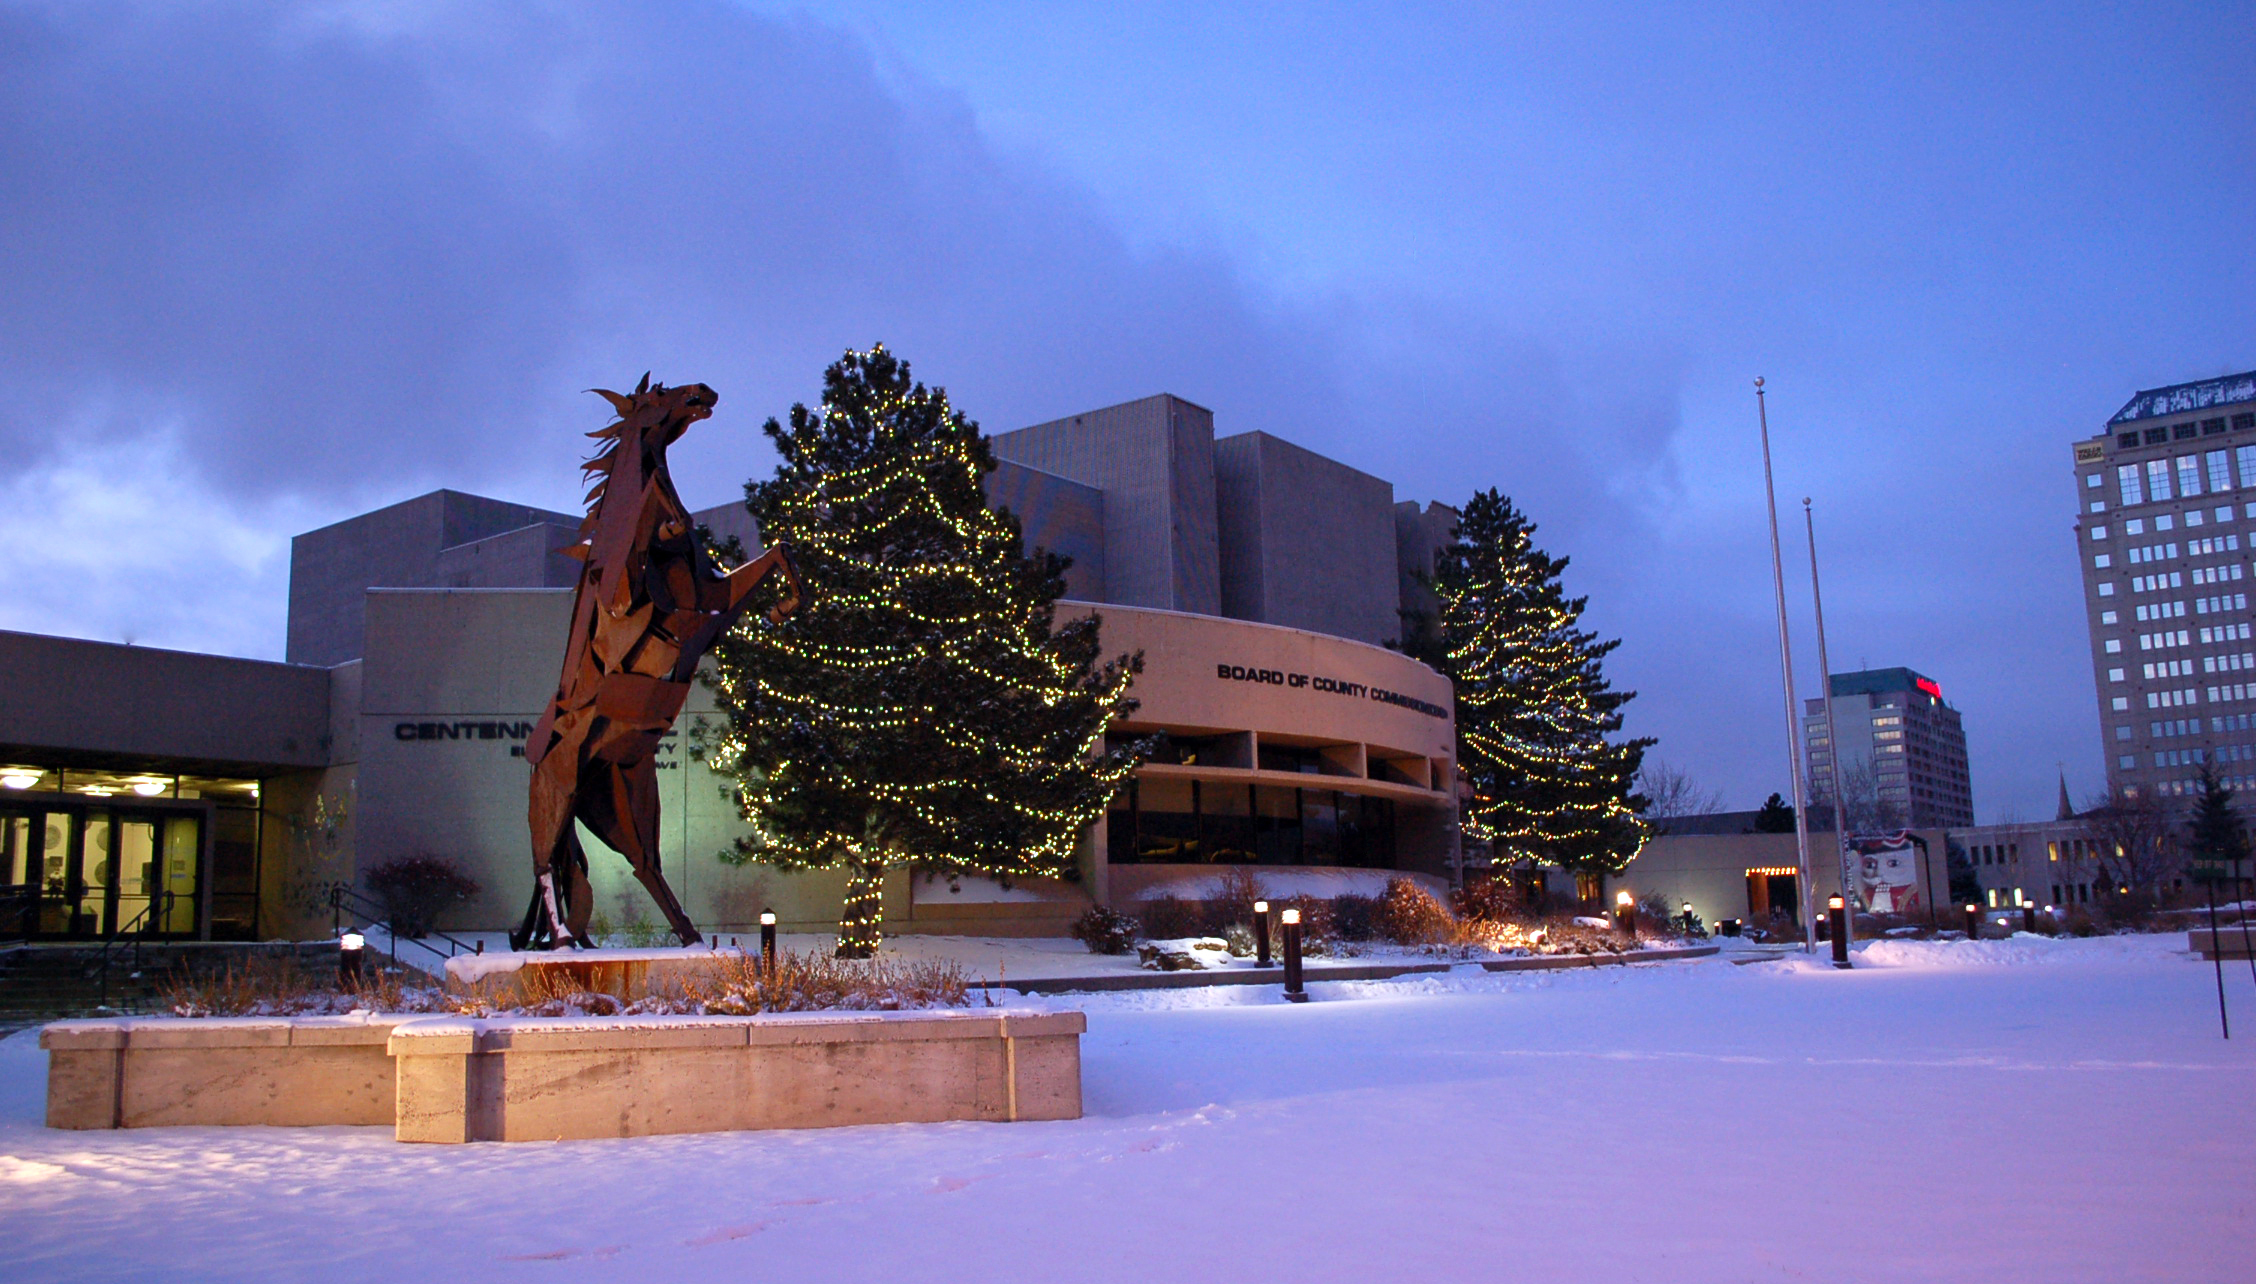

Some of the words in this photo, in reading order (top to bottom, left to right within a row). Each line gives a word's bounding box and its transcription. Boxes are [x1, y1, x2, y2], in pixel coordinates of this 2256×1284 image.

[1217, 664, 1284, 685] BOARD
[1288, 672, 1309, 688] OF
[1312, 676, 1368, 699] COUNTY
[395, 722, 535, 741] CENTENN
